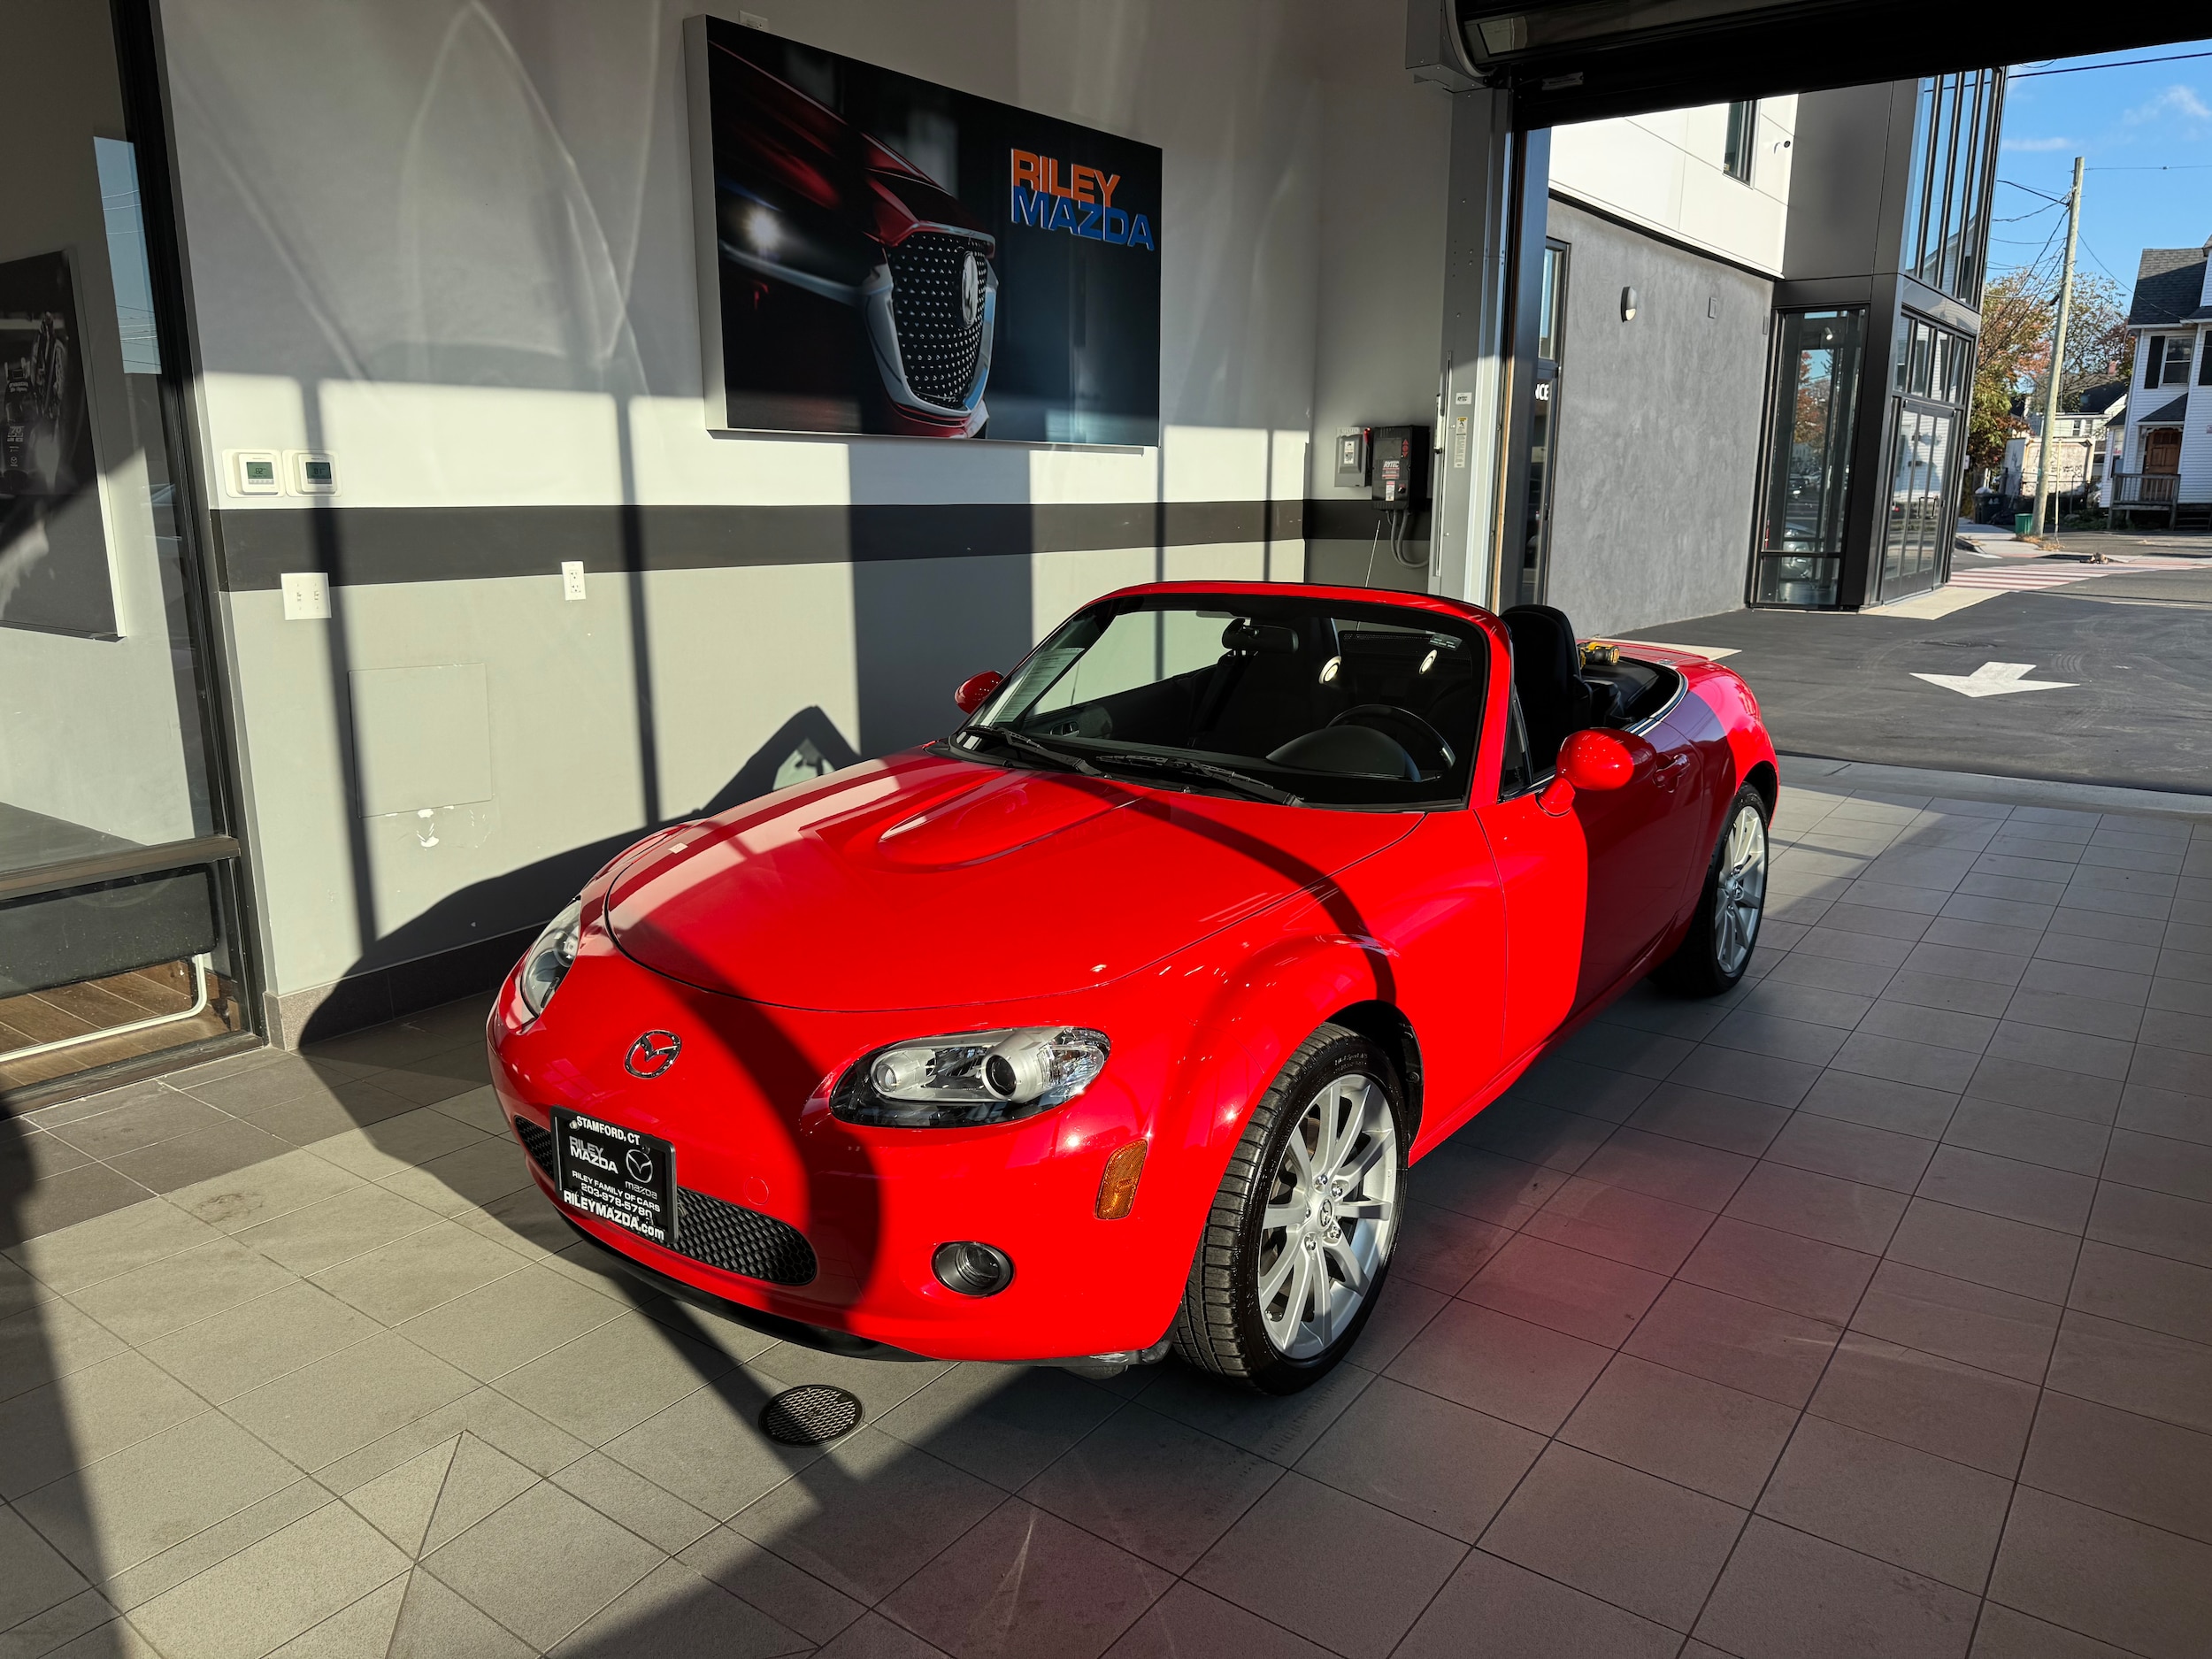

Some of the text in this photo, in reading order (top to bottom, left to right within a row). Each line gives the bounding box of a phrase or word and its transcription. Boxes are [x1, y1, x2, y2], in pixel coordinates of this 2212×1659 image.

[1011, 148, 1120, 208] RILEY
[1011, 186, 1155, 251] MAZDA
[569, 1135, 604, 1156] RILEY
[576, 1115, 641, 1146] STAMFORD, CT
[570, 1146, 619, 1174] MAZDA
[572, 1170, 661, 1212] RILEY FAMILY OF CARS
[625, 1180, 658, 1200] mazda
[563, 1189, 664, 1240] RILEYMAZDA.com
